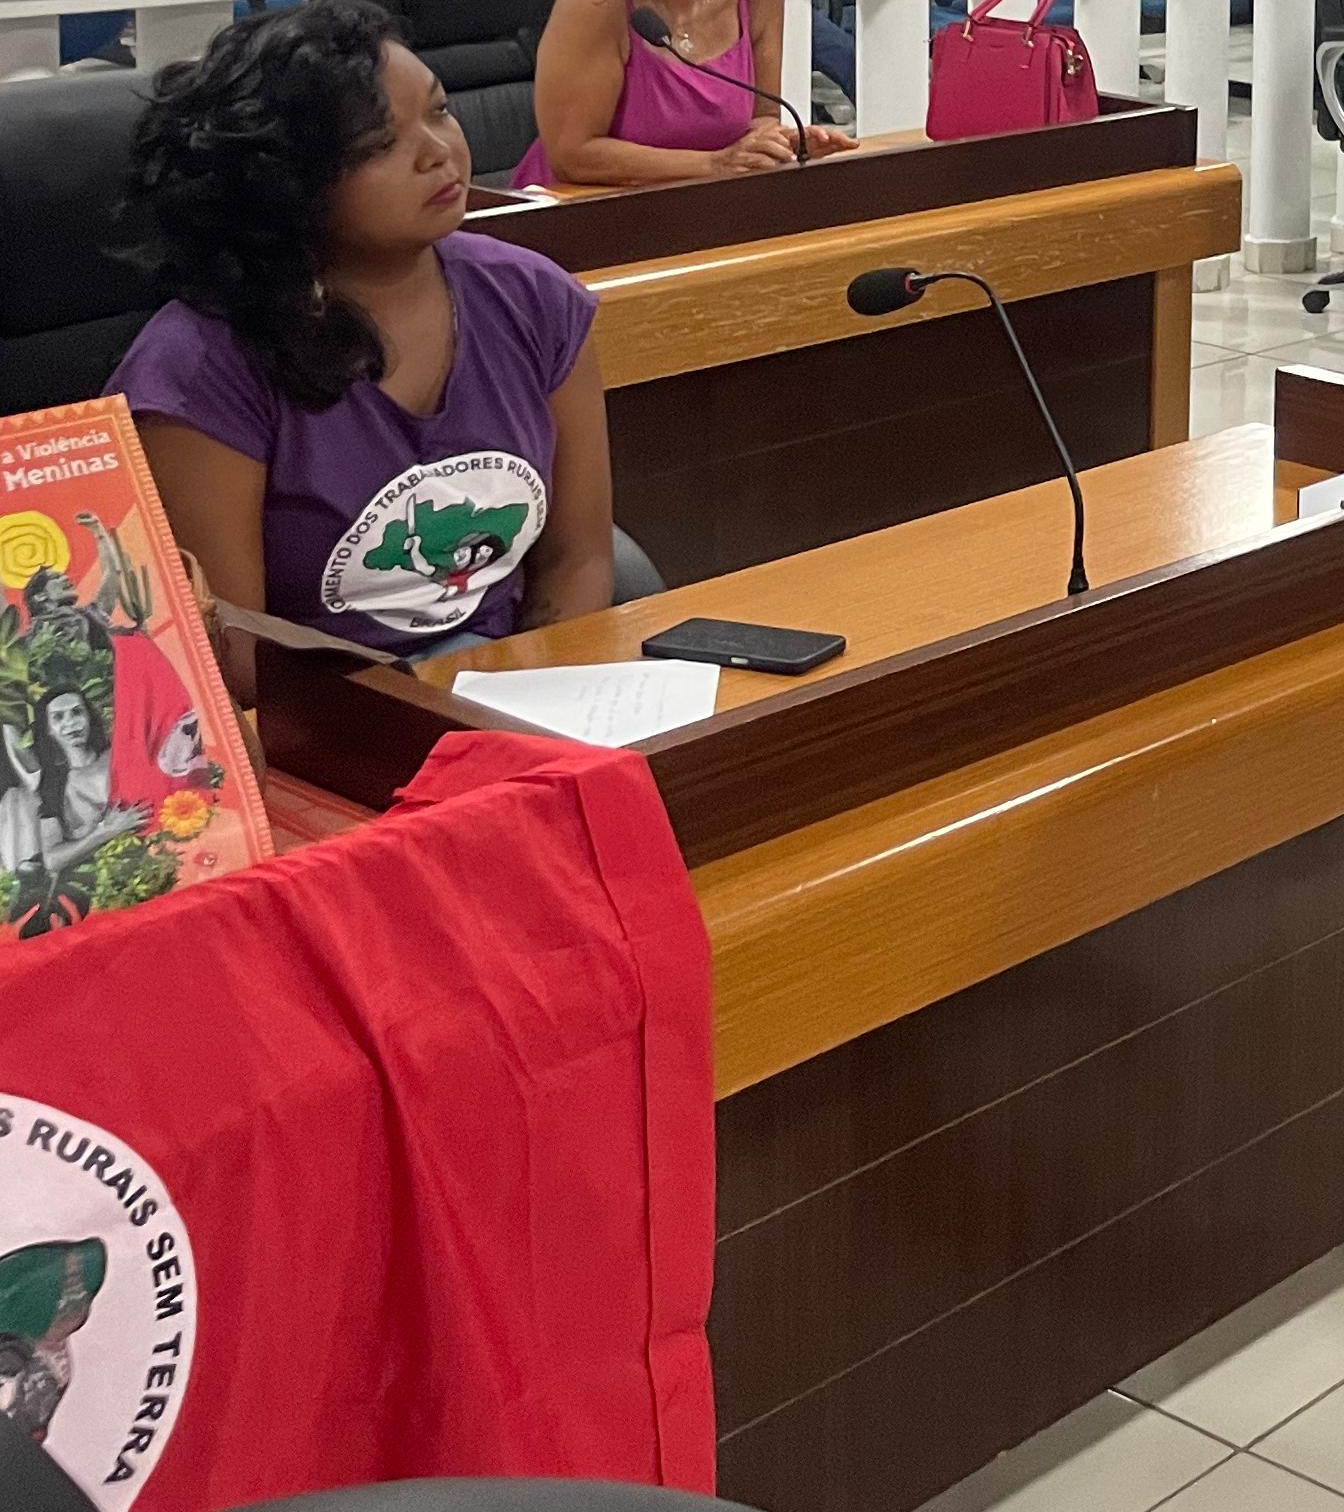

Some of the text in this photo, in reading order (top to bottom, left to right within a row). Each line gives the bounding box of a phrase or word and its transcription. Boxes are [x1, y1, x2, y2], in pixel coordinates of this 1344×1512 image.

[16, 429, 112, 461] Violência
[3, 452, 119, 492] Meninas
[346, 511, 378, 545] DOS
[506, 459, 543, 502] RURAIS
[409, 608, 467, 629] BRASIL
[26, 1117, 184, 1485] RURAIS SEM TERRA
